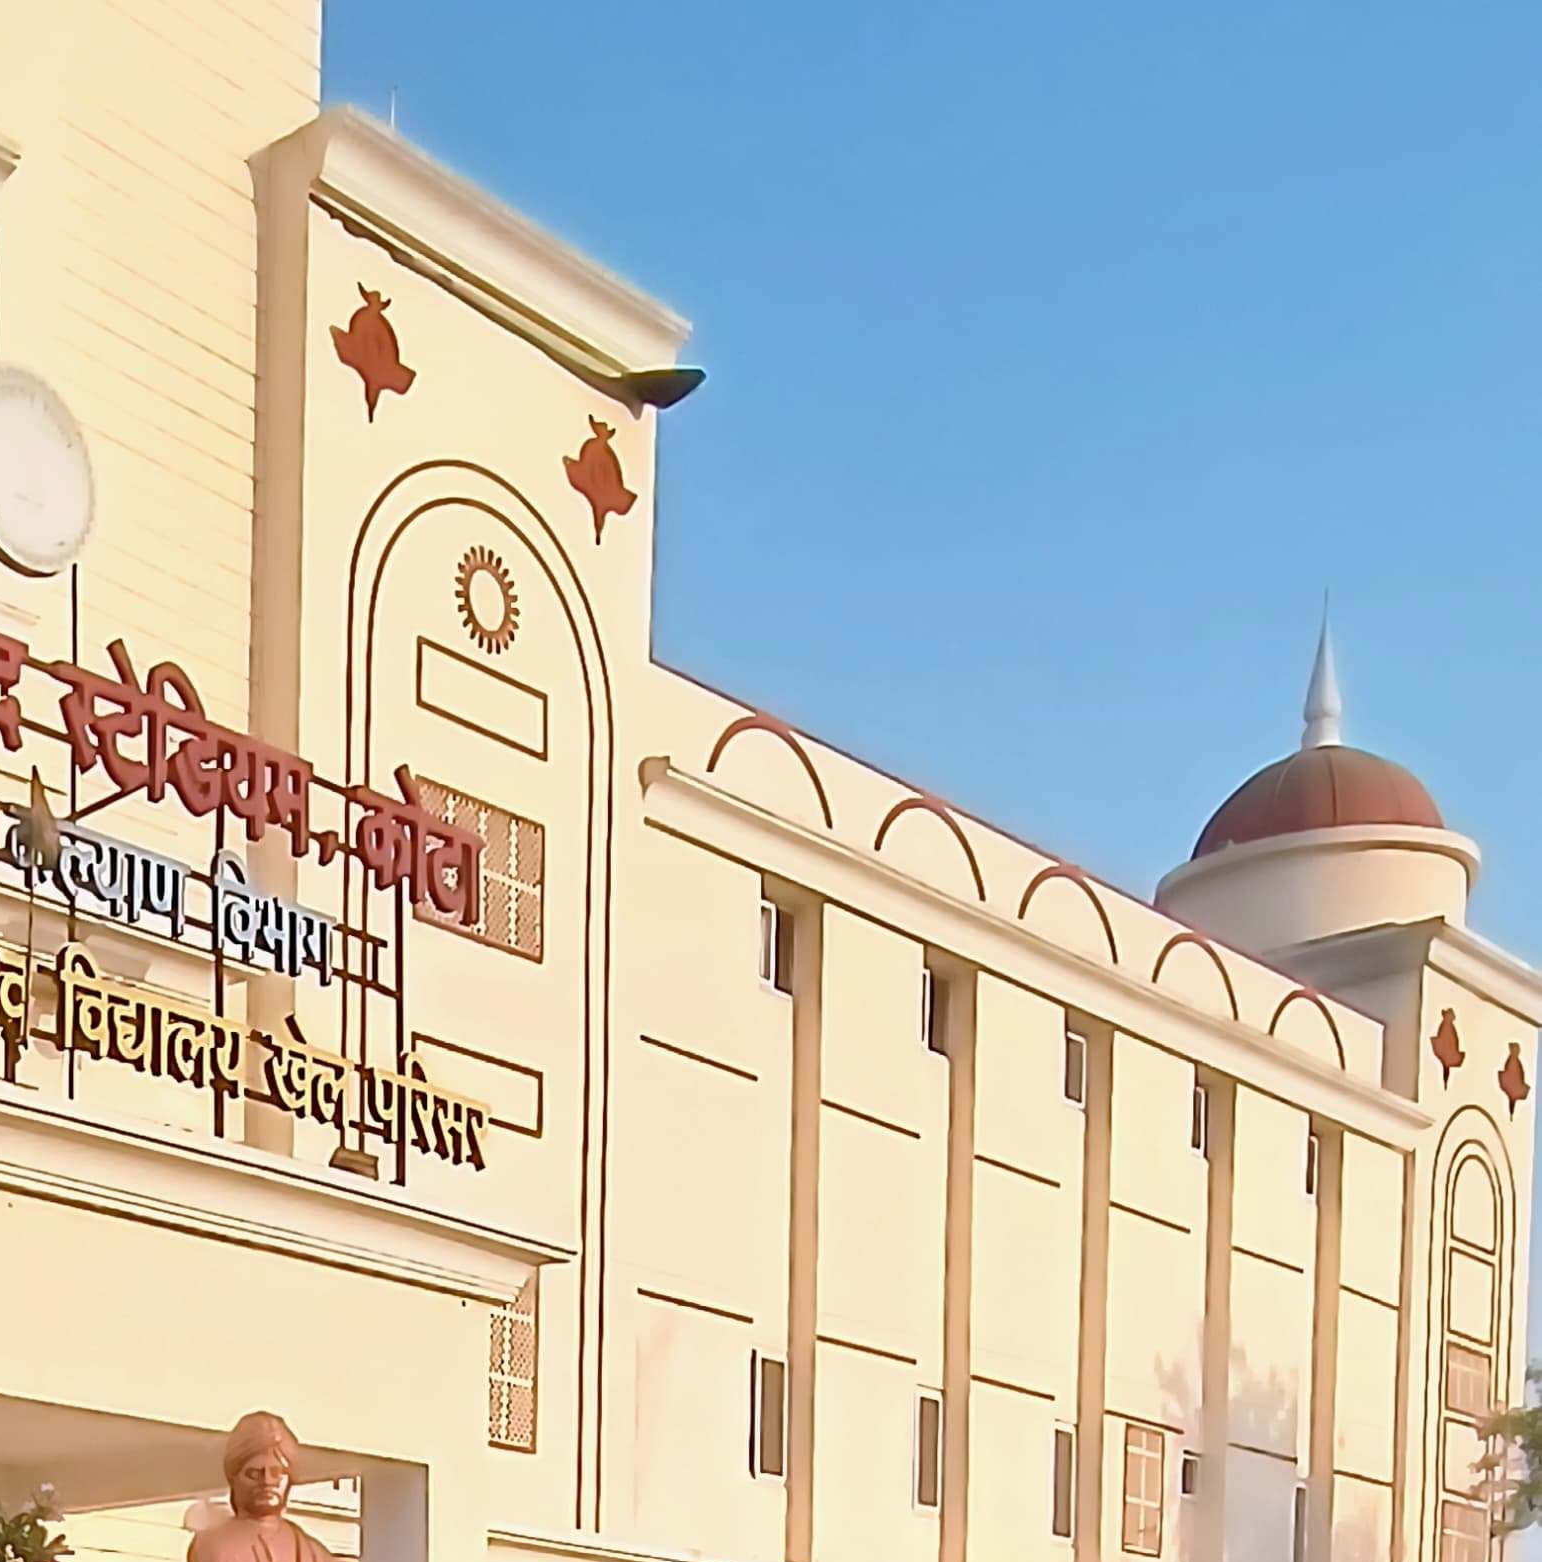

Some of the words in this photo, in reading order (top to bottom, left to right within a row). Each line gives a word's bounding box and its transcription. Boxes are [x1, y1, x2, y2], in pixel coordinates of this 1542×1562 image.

[212, 850, 343, 986] विभाग
[348, 764, 485, 927] कोटा
[58, 941, 248, 1099] विद्यालय
[263, 1014, 354, 1130] खेल
[359, 1045, 493, 1171] परिसर
